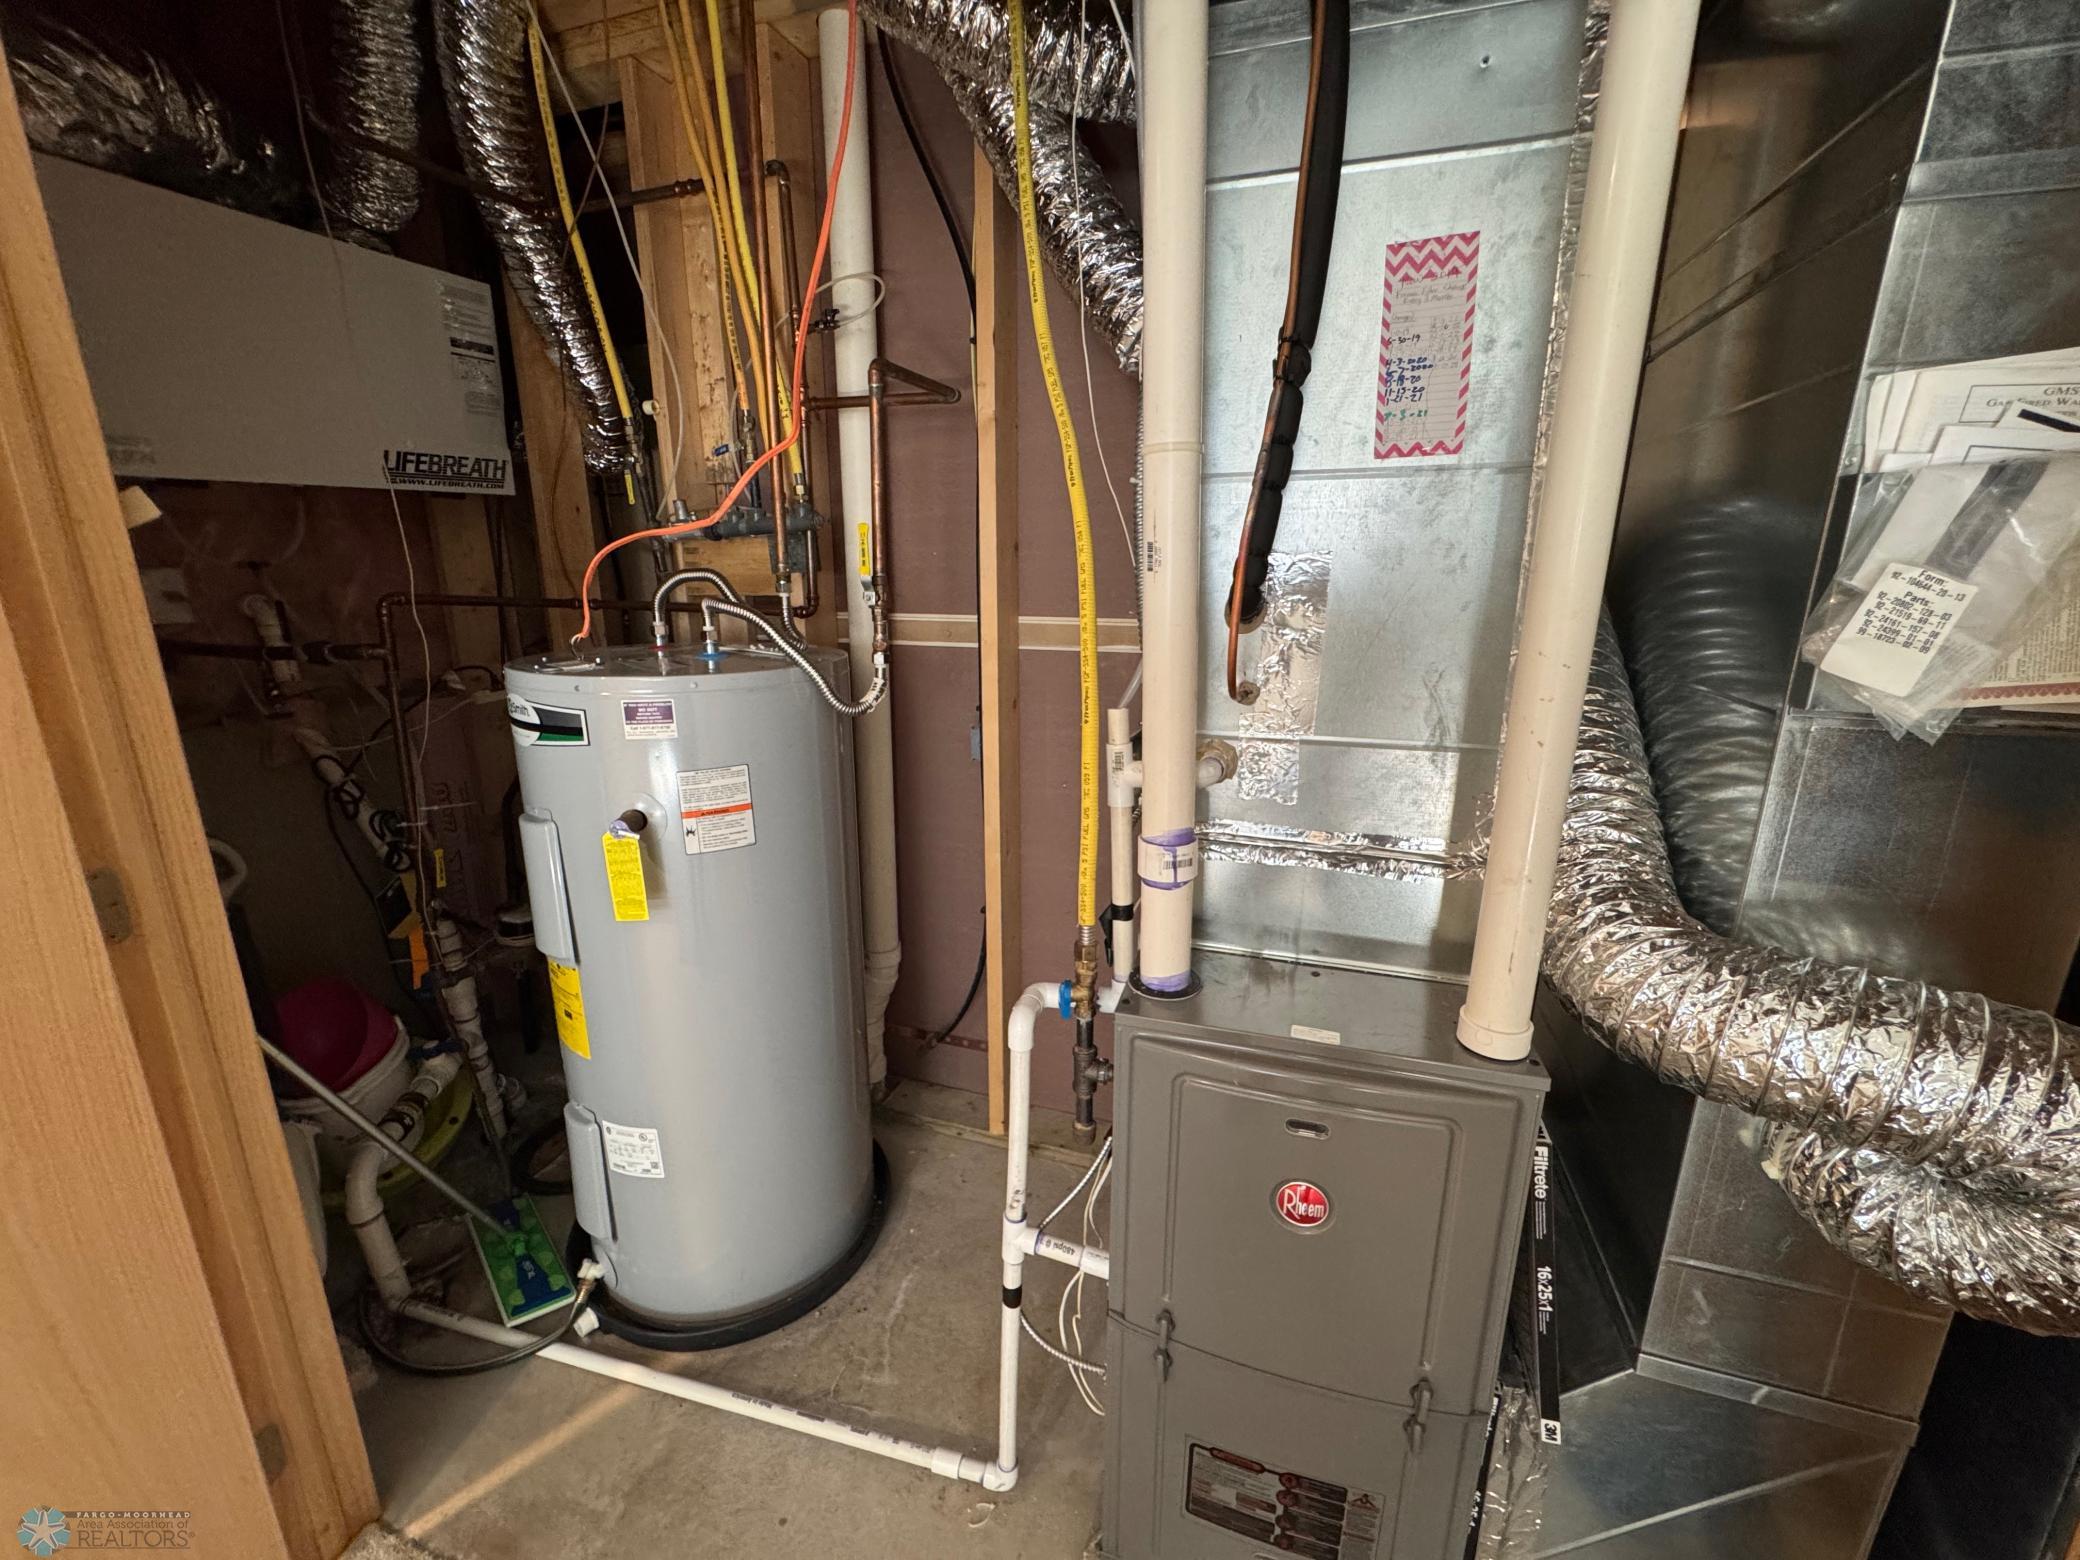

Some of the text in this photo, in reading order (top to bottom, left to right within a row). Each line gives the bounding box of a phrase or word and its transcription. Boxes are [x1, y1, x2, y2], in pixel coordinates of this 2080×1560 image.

[383, 450, 507, 479] LIFEBREATH
[1533, 1145, 1549, 1200] Filtrete
[1283, 1185, 1325, 1220] Rheem
[1536, 1265, 1554, 1312] 16x25x1
[1543, 1422, 1558, 1442] 3M
